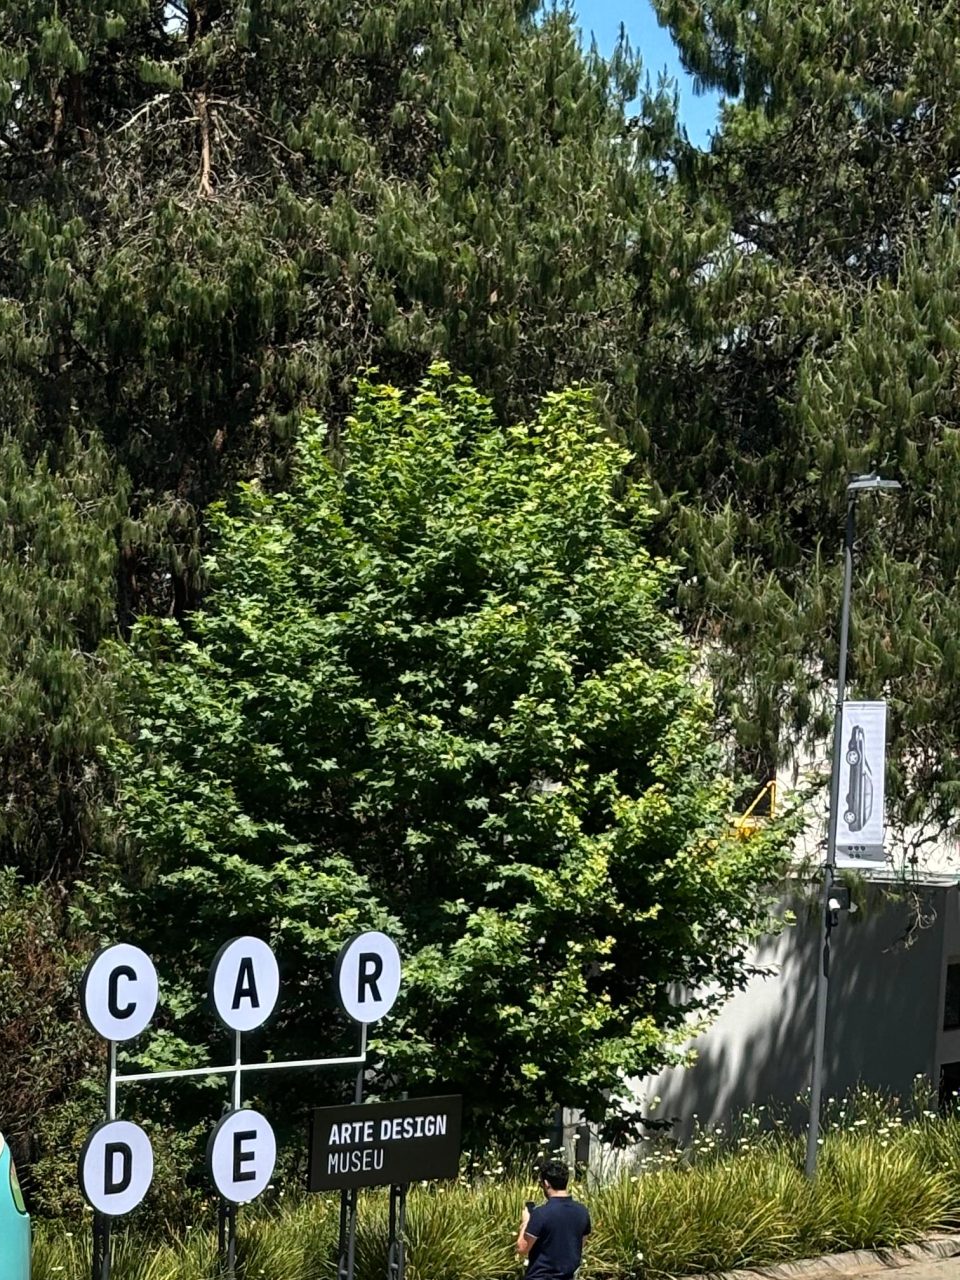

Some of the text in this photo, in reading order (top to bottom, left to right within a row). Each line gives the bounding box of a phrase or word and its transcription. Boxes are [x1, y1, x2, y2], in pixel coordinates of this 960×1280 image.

[328, 1114, 447, 1145] ARTE DESIGN
[327, 1148, 384, 1175] MUSEU
